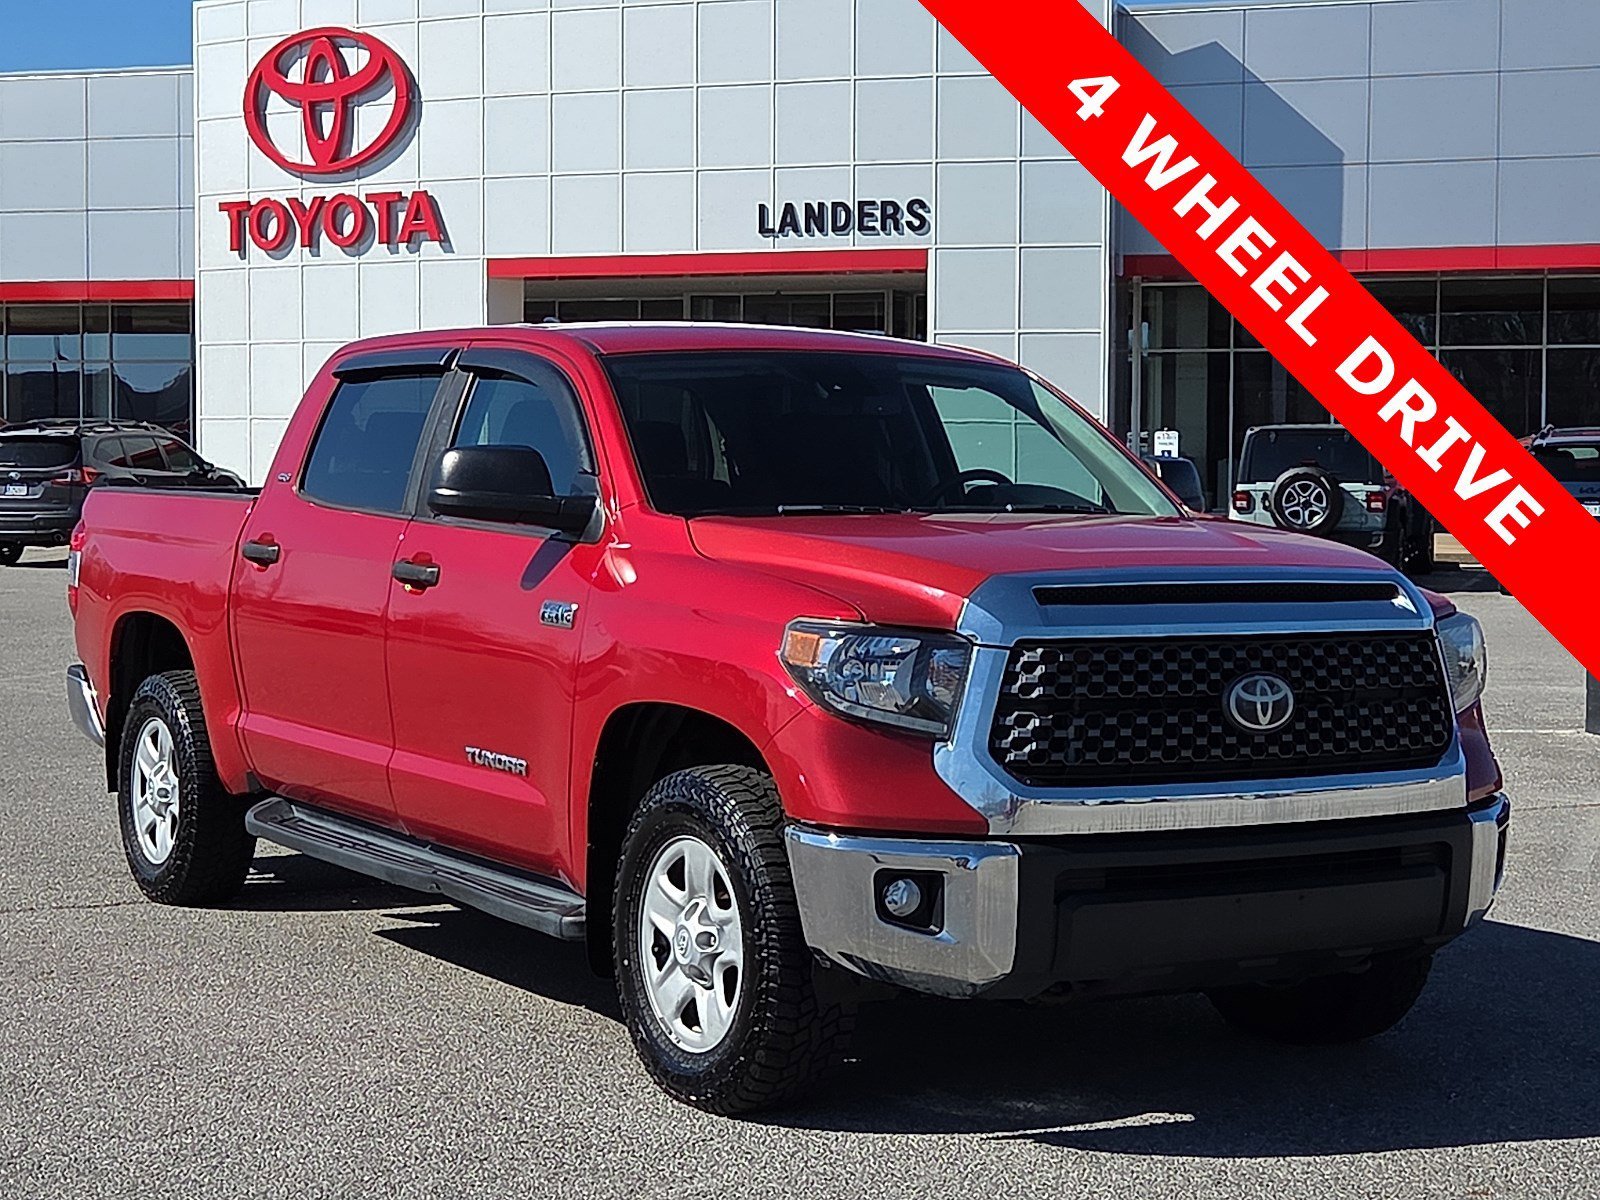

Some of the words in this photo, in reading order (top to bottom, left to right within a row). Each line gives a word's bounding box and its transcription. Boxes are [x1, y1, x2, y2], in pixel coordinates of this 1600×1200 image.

[218, 190, 445, 252] TOYOTA
[758, 196, 931, 238] LANDERS
[464, 745, 528, 777] TUNDRA
